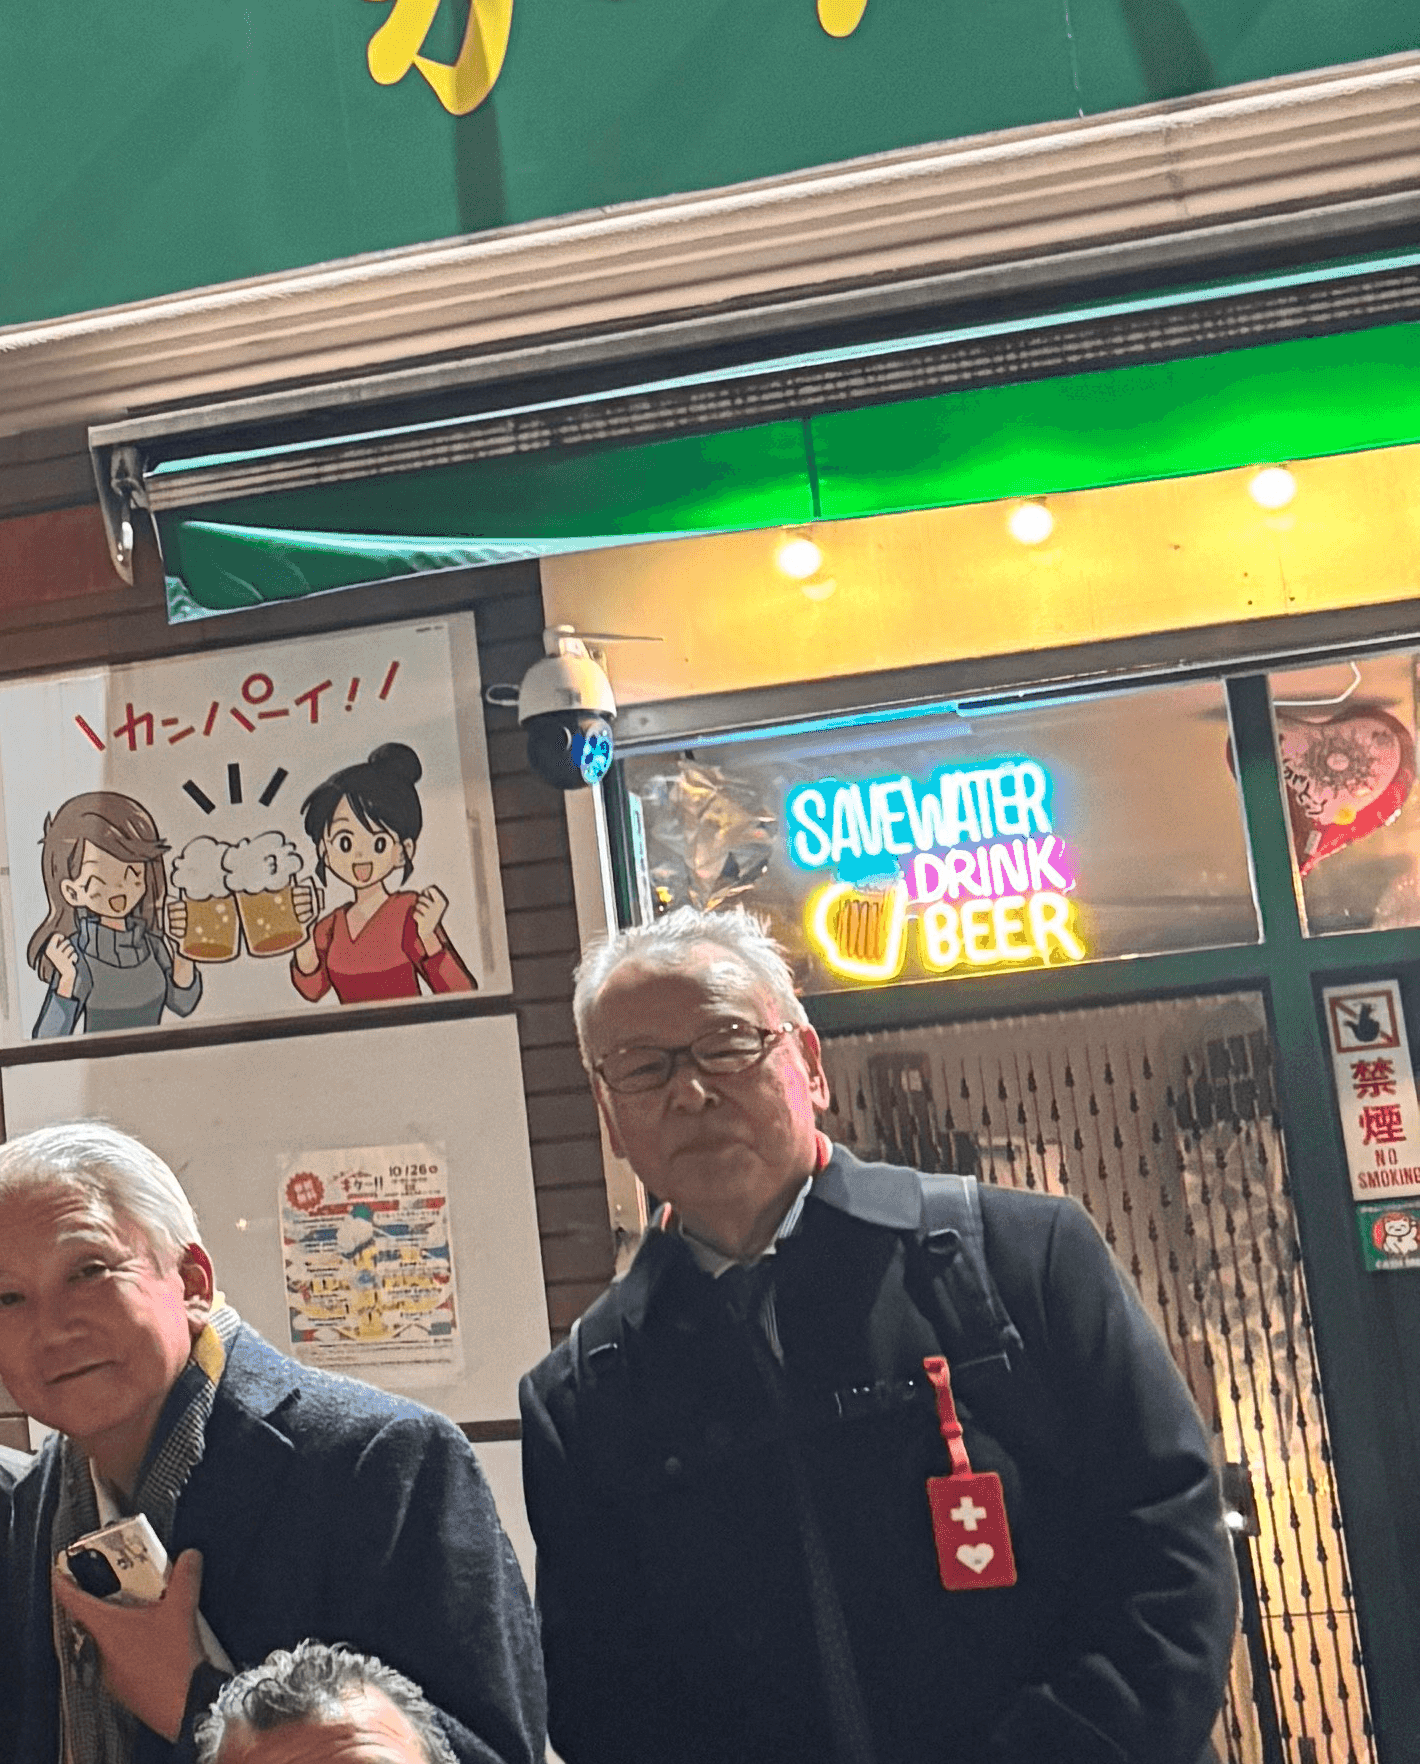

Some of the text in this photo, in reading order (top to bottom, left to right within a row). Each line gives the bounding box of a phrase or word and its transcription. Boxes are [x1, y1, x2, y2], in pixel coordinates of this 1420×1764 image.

[912, 834, 1067, 904] DRINK
[922, 891, 1087, 968] BEER
[1350, 1055, 1408, 1145] 禁煙
[1375, 1148, 1398, 1167] NO
